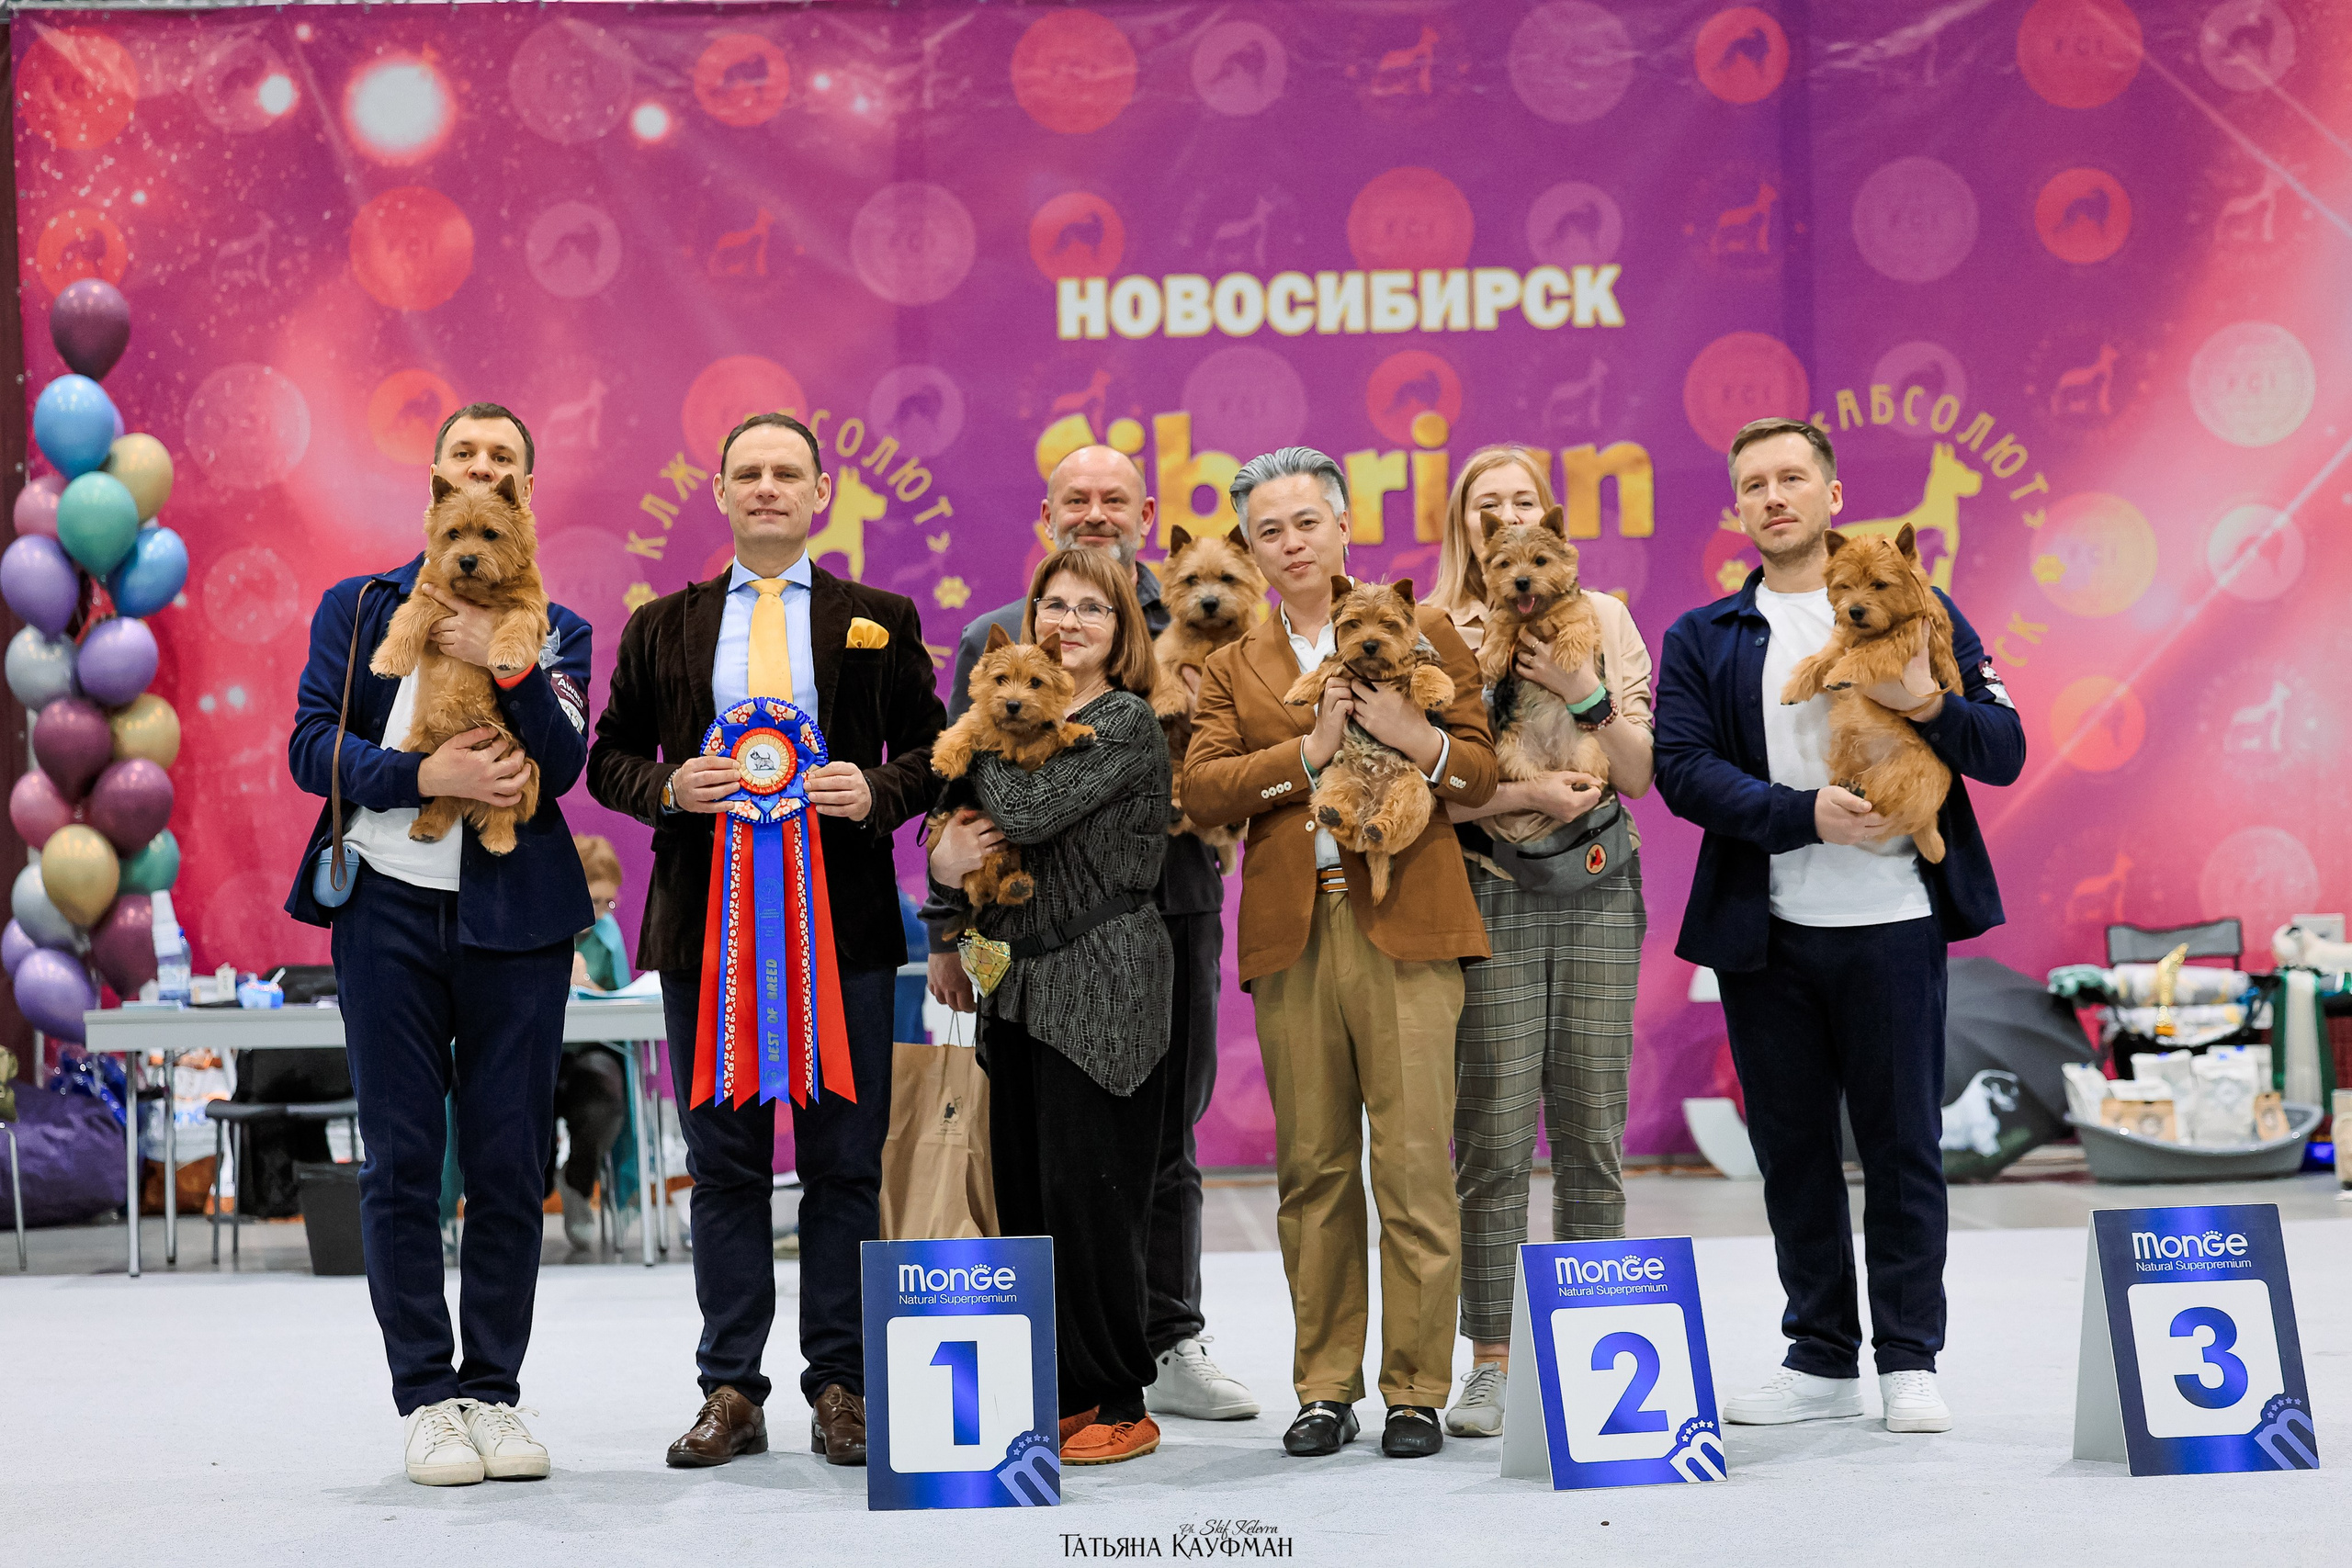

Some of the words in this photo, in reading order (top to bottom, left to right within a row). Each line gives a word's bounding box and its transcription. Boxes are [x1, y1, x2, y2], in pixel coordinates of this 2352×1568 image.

[1056, 264, 1625, 341] НОВОСИБИРСК
[625, 451, 708, 560] КЛЖ
[717, 407, 954, 552] СОЛЮТ»
[765, 958, 779, 1001] BREED
[768, 1006, 780, 1025] OF
[767, 1030, 781, 1063] BEST
[2135, 1261, 2174, 1272] Natural
[2176, 1258, 2252, 1272] Superpremium
[899, 1293, 937, 1305] Natural
[939, 1292, 1017, 1306] Superpremium
[1558, 1285, 1595, 1297] Natural
[1596, 1283, 1668, 1297] Superpremium
[2169, 1306, 2249, 1409] 3
[930, 1340, 980, 1446] 1
[1590, 1331, 1669, 1436] 2
